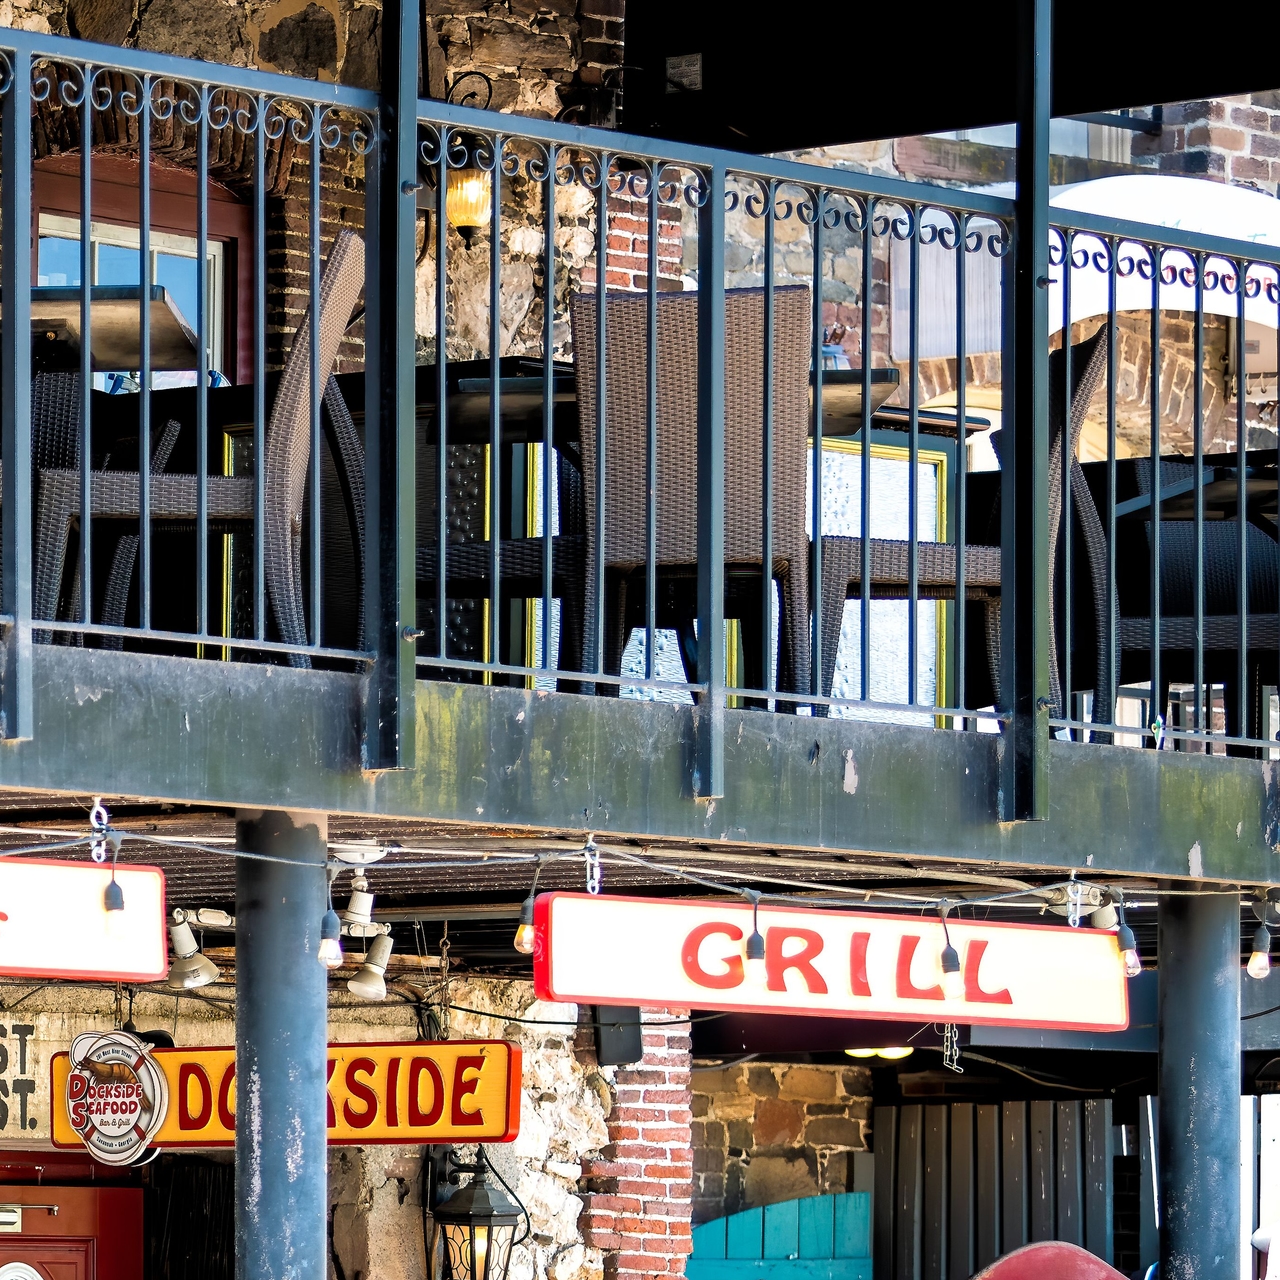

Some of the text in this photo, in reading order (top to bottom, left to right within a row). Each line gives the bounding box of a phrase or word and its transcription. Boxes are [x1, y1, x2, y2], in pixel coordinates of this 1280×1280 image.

[681, 921, 1012, 1005] GRILL
[71, 1102, 138, 1129] SEAFOOD
[178, 1056, 487, 1131] DOSIDE
